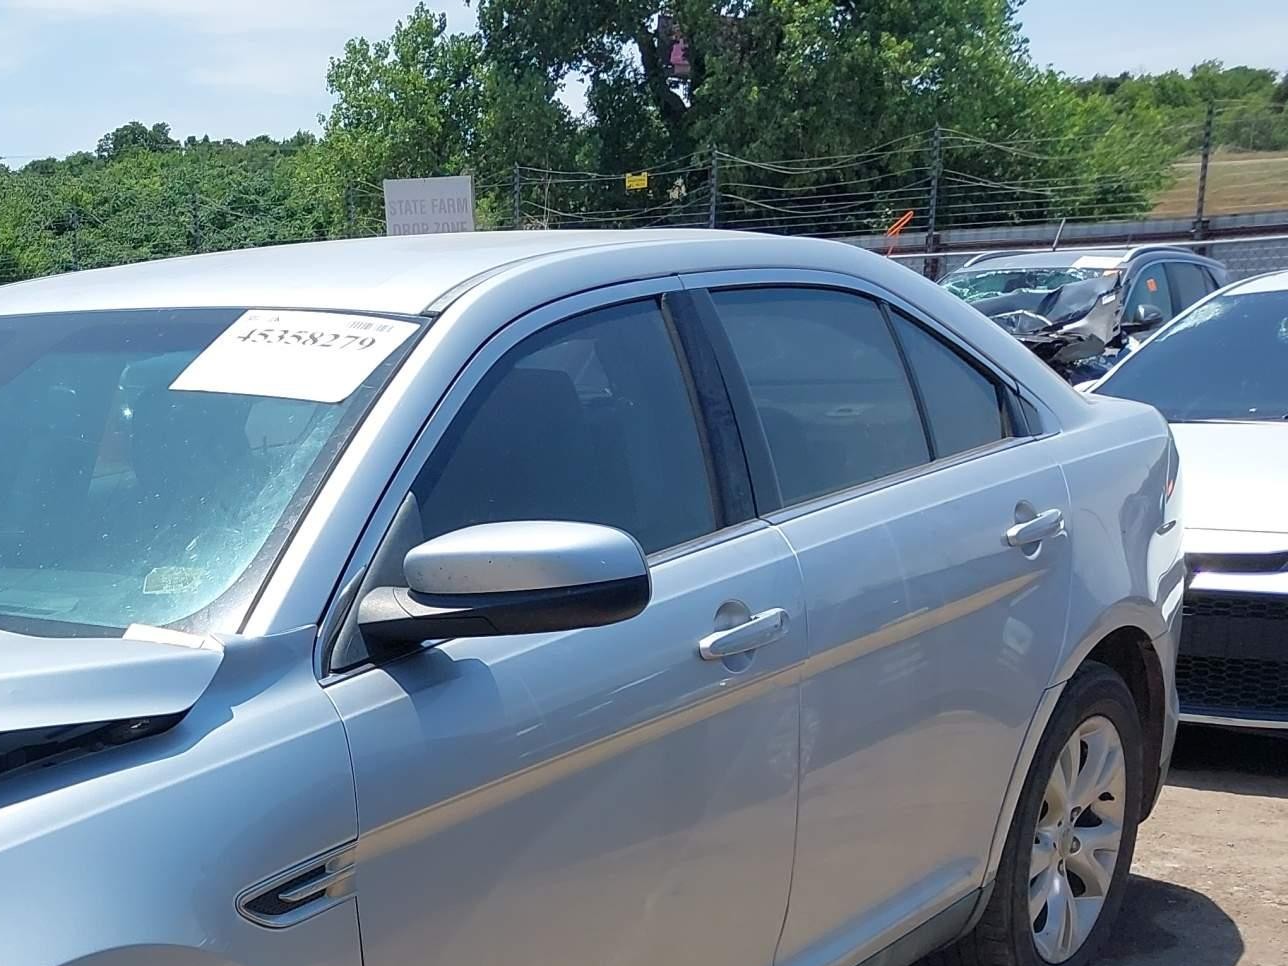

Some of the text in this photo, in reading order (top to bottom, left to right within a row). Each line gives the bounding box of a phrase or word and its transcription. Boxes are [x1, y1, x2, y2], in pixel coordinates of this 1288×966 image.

[390, 198, 468, 216] STATE FARM
[393, 221, 468, 235] DROP ZONE
[238, 328, 376, 350] 45358279
